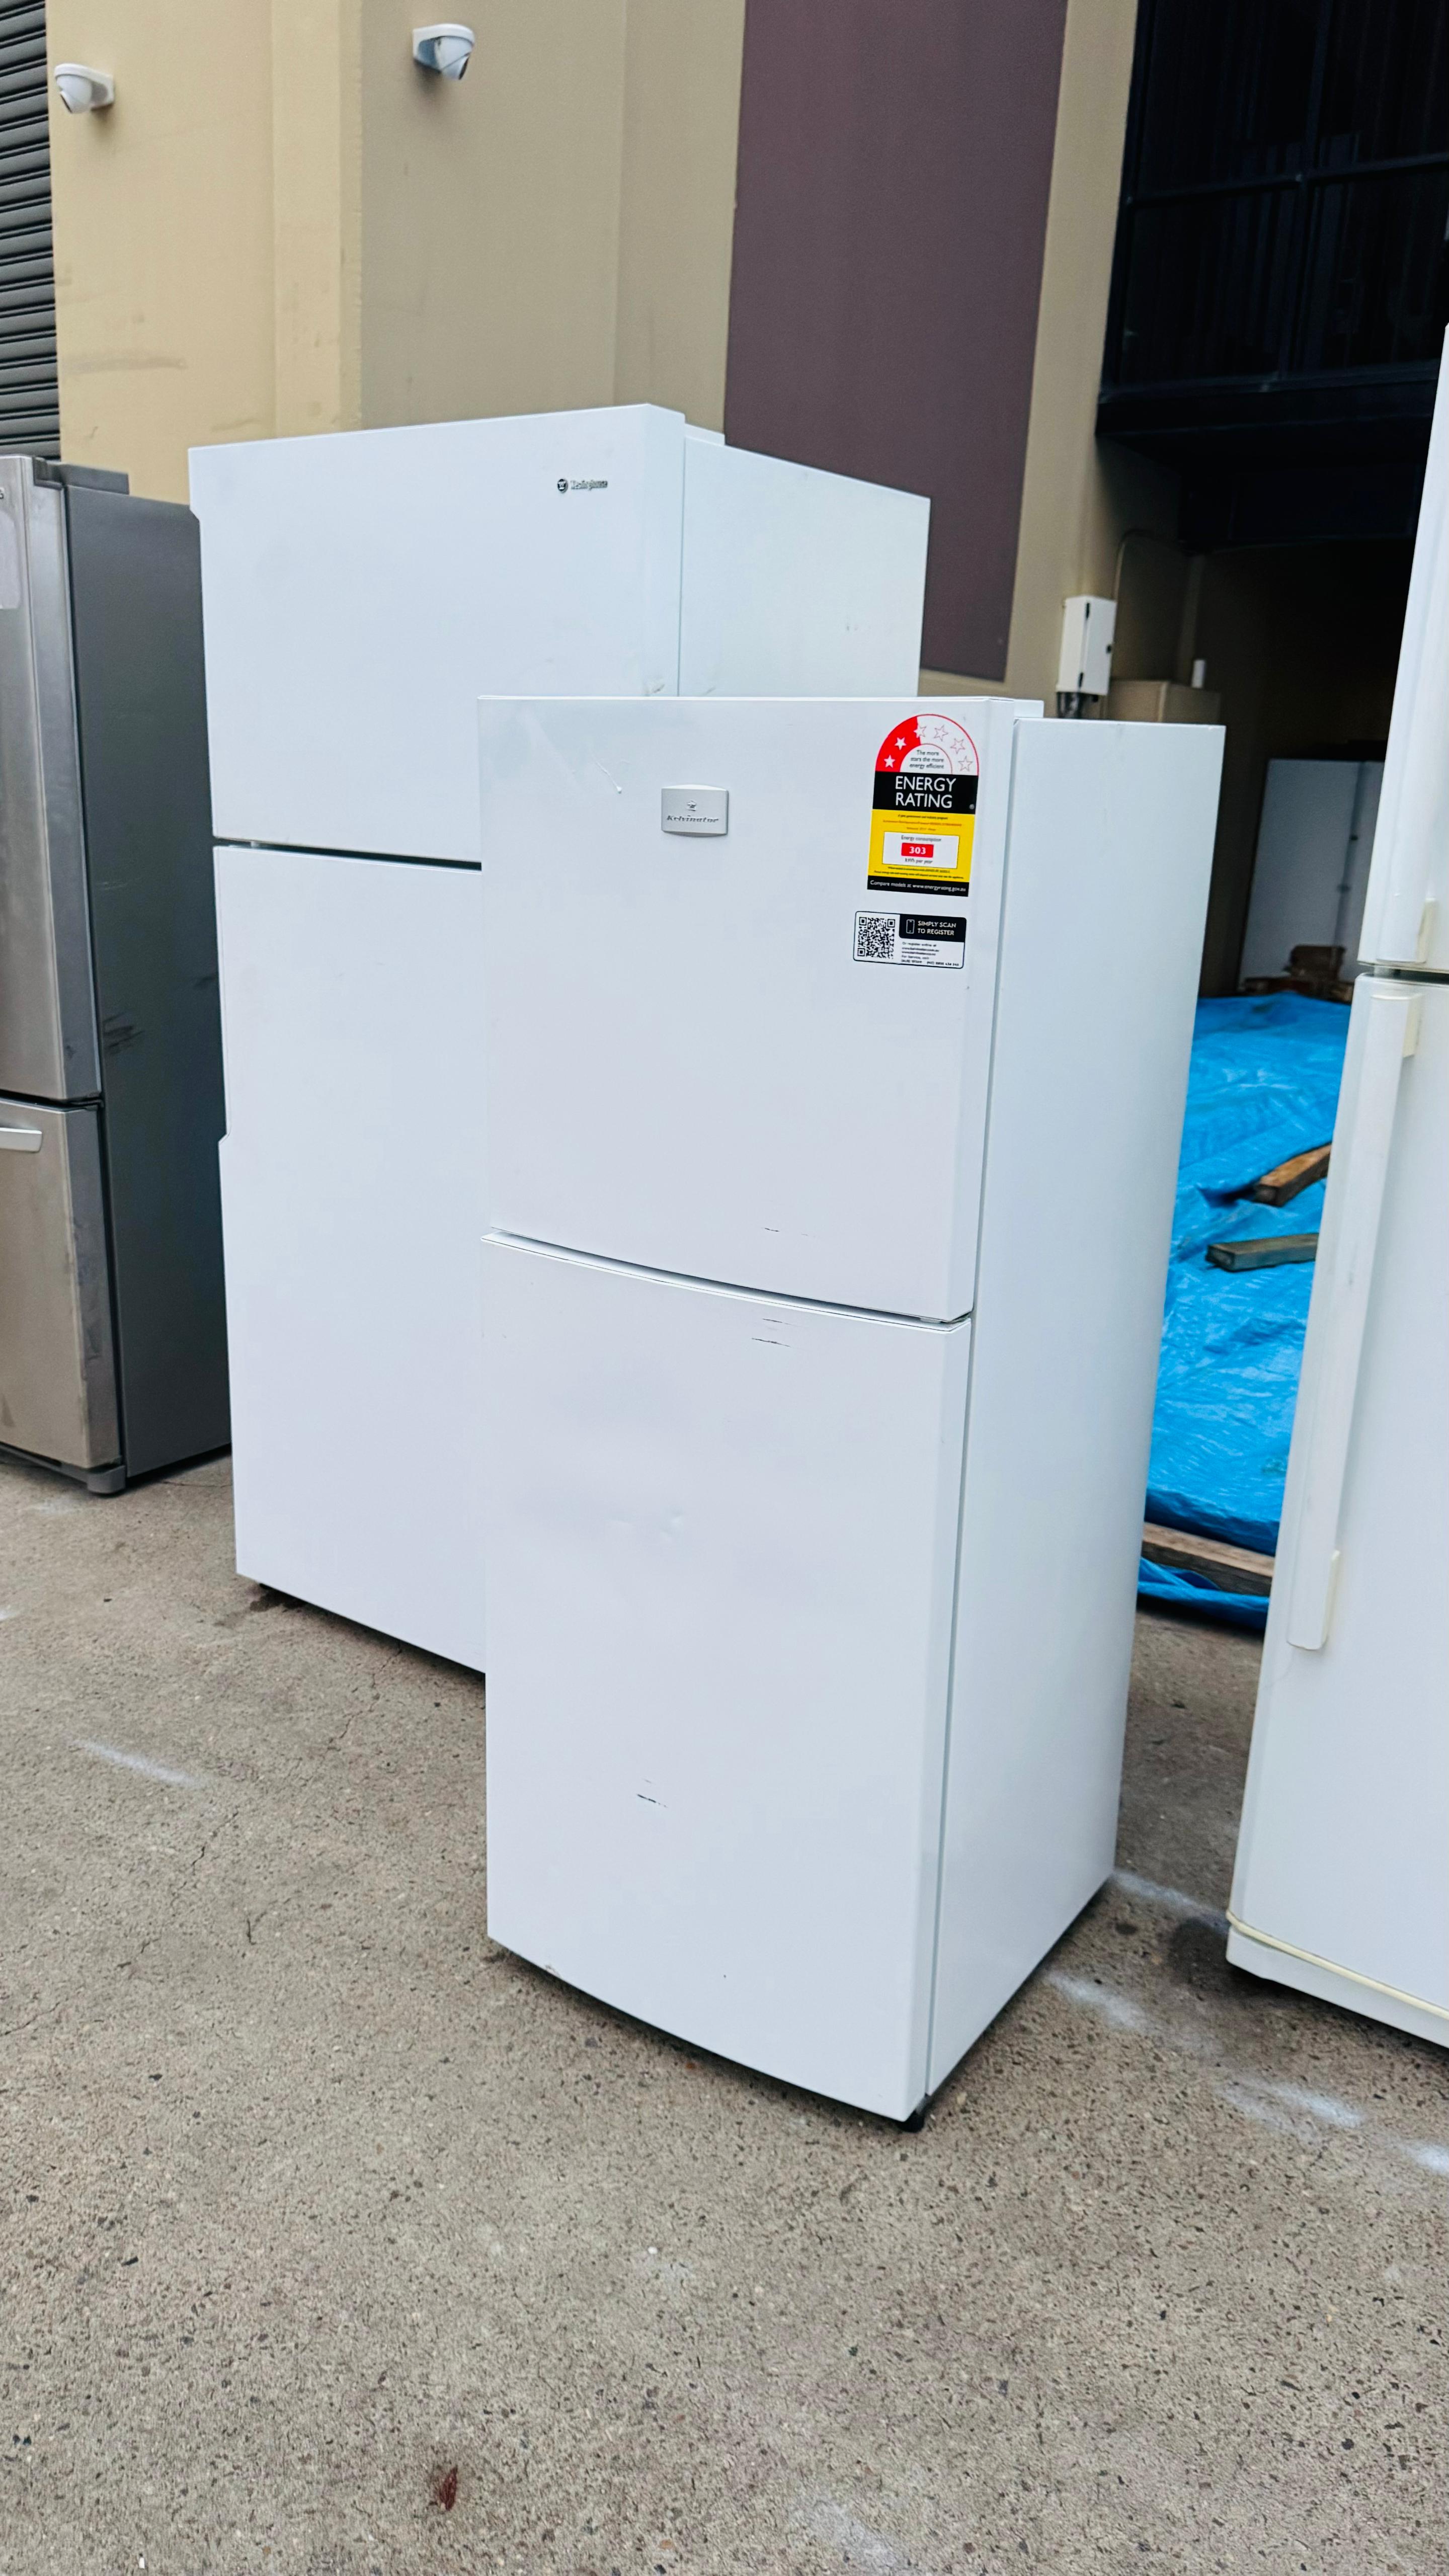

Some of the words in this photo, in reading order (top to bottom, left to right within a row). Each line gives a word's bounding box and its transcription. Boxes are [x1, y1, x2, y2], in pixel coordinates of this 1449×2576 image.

[895, 776, 956, 792] ENERGY
[896, 792, 953, 808] RATING
[667, 815, 719, 823] Kelvinator
[909, 846, 926, 855] 303
